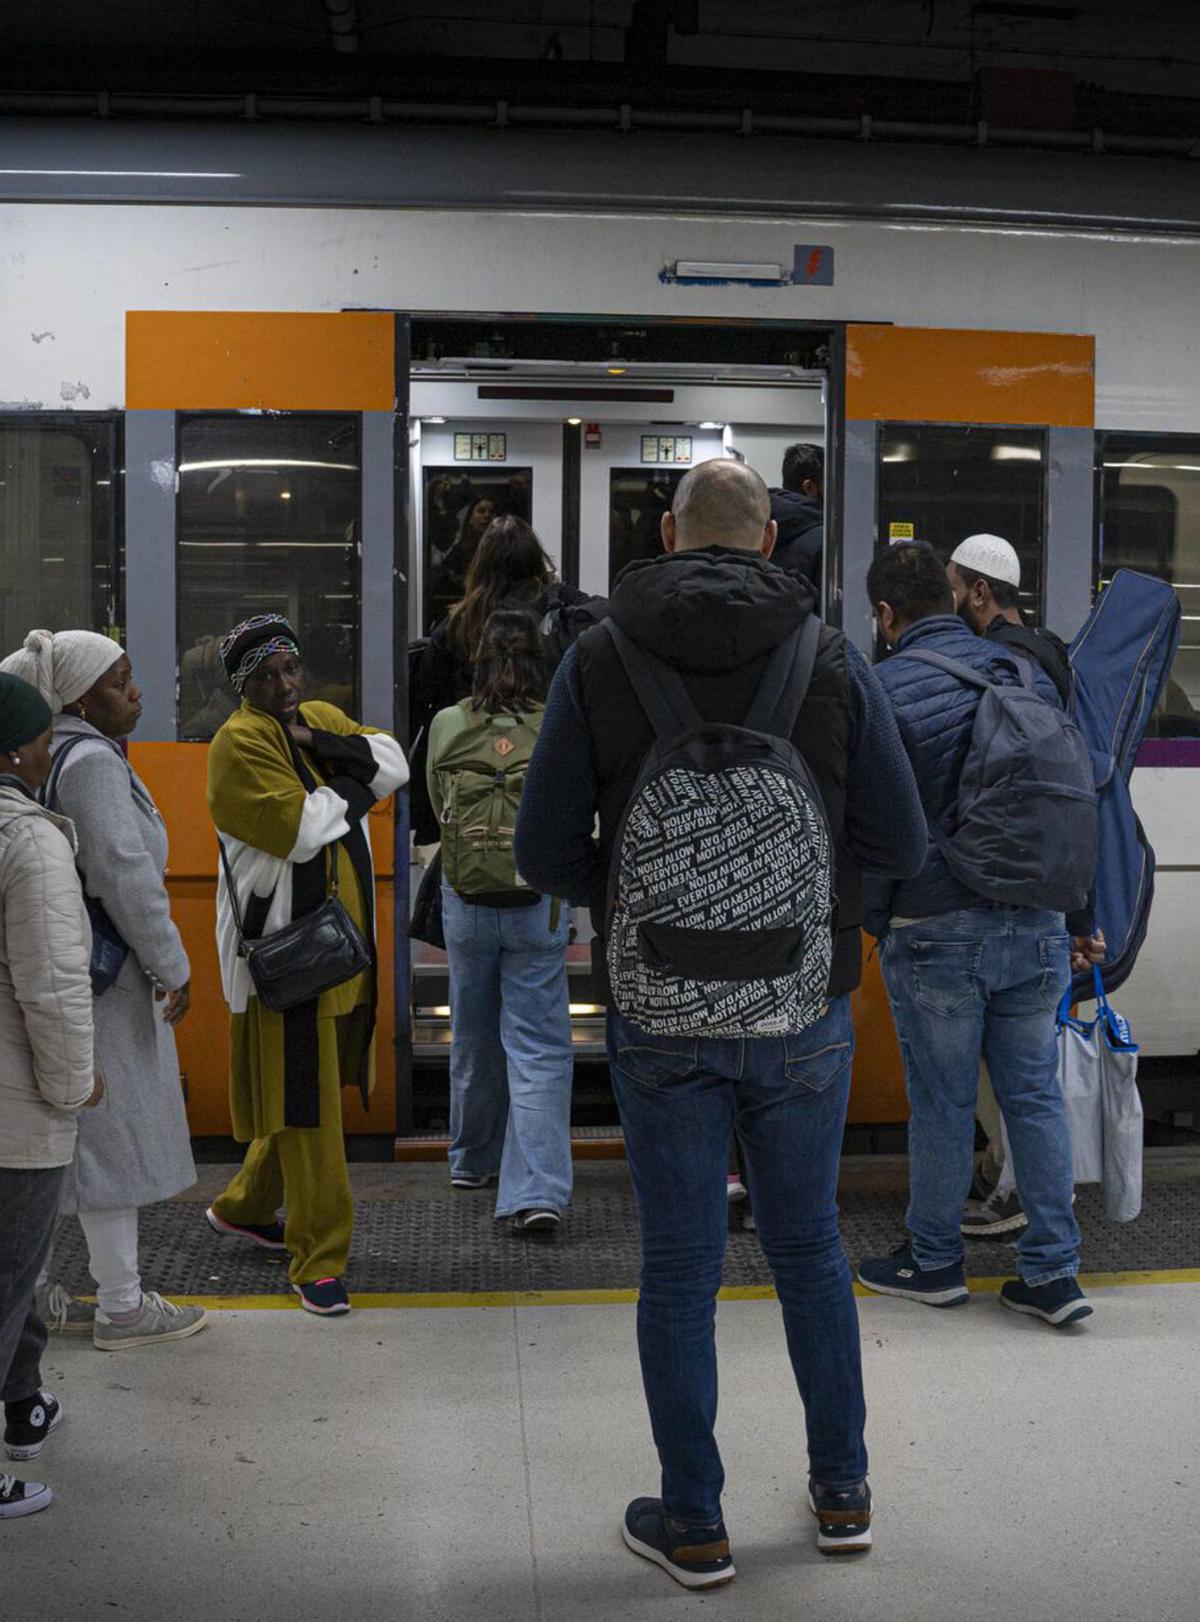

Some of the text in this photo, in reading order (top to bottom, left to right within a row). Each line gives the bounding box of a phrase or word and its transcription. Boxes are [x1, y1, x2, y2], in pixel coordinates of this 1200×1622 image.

[666, 816, 716, 839] EVERYDAY
[642, 857, 691, 885] EVERYDAY
[648, 868, 697, 896] EVERYDAY
[763, 850, 811, 890] EVERYDAY
[677, 877, 729, 907] EVERYDAY
[710, 882, 761, 918] EVERYDAY
